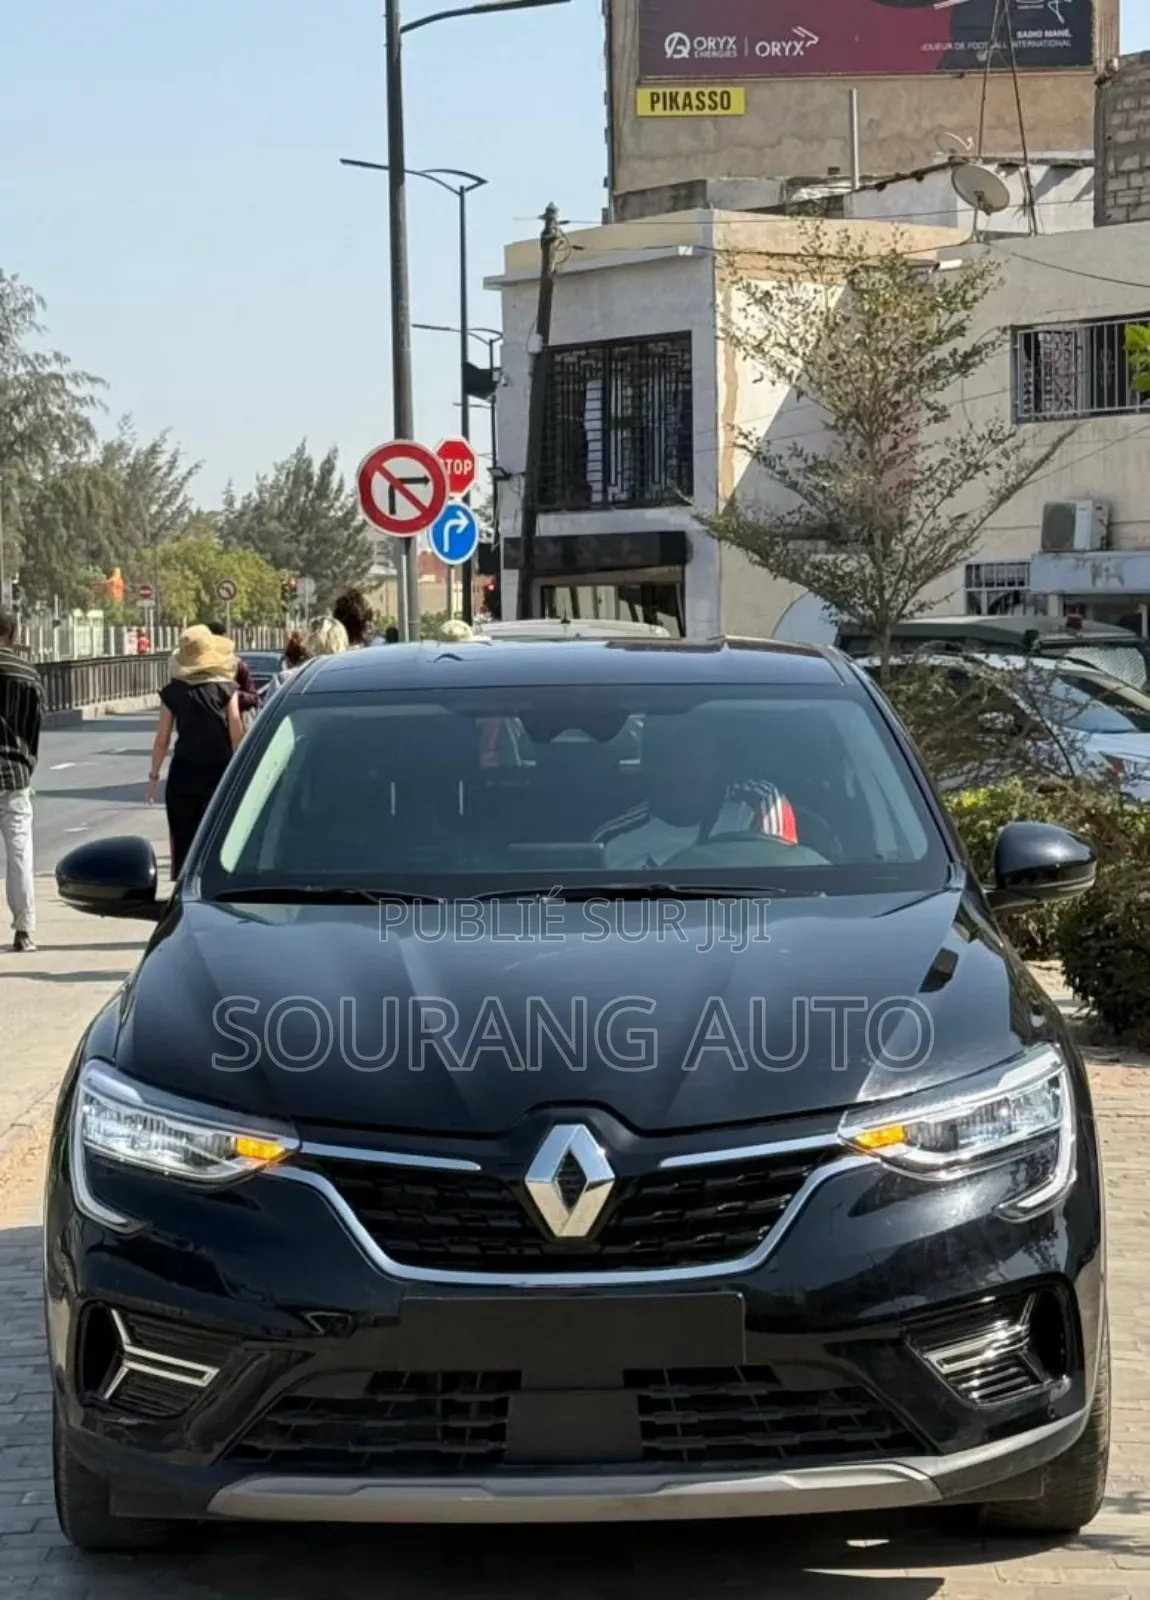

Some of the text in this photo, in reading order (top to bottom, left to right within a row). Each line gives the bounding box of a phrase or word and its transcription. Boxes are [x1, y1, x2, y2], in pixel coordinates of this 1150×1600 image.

[693, 36, 737, 50] ORYX
[755, 41, 804, 57] ORYX
[967, 41, 1008, 50] FOOTALL
[650, 89, 731, 112] PIKASSO
